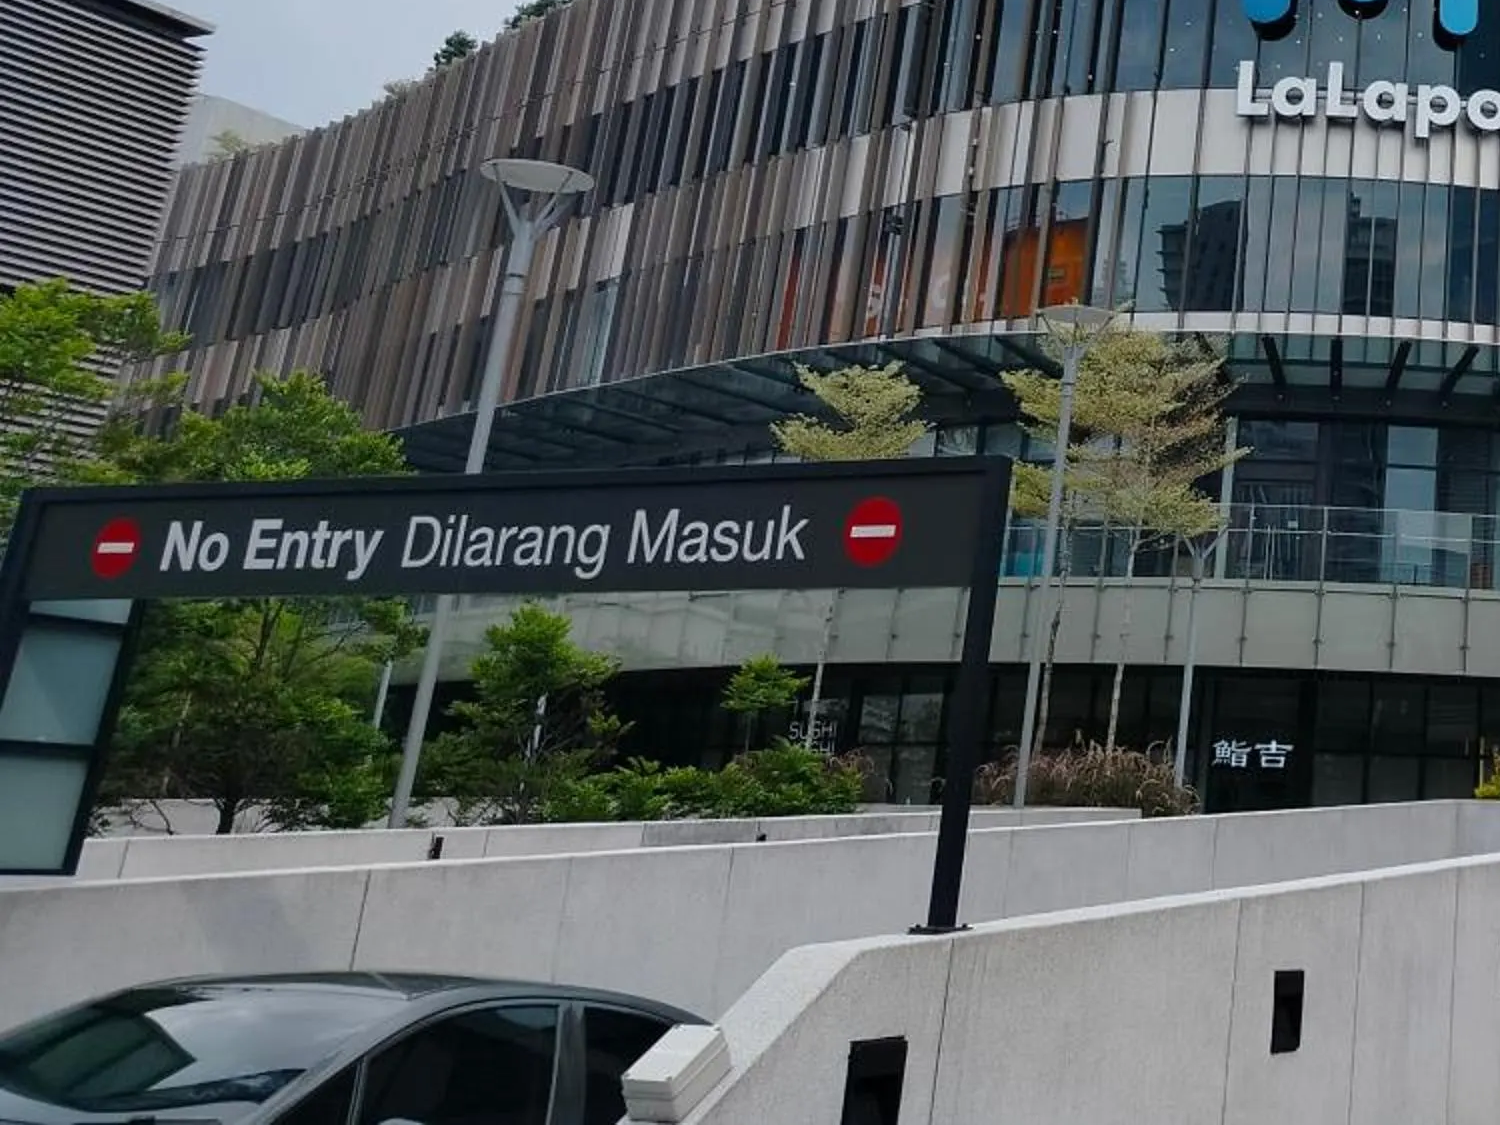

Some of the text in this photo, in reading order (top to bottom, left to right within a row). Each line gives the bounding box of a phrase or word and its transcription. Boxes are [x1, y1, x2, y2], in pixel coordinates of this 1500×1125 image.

[159, 505, 810, 580] No Entry Dilarang Masuk
